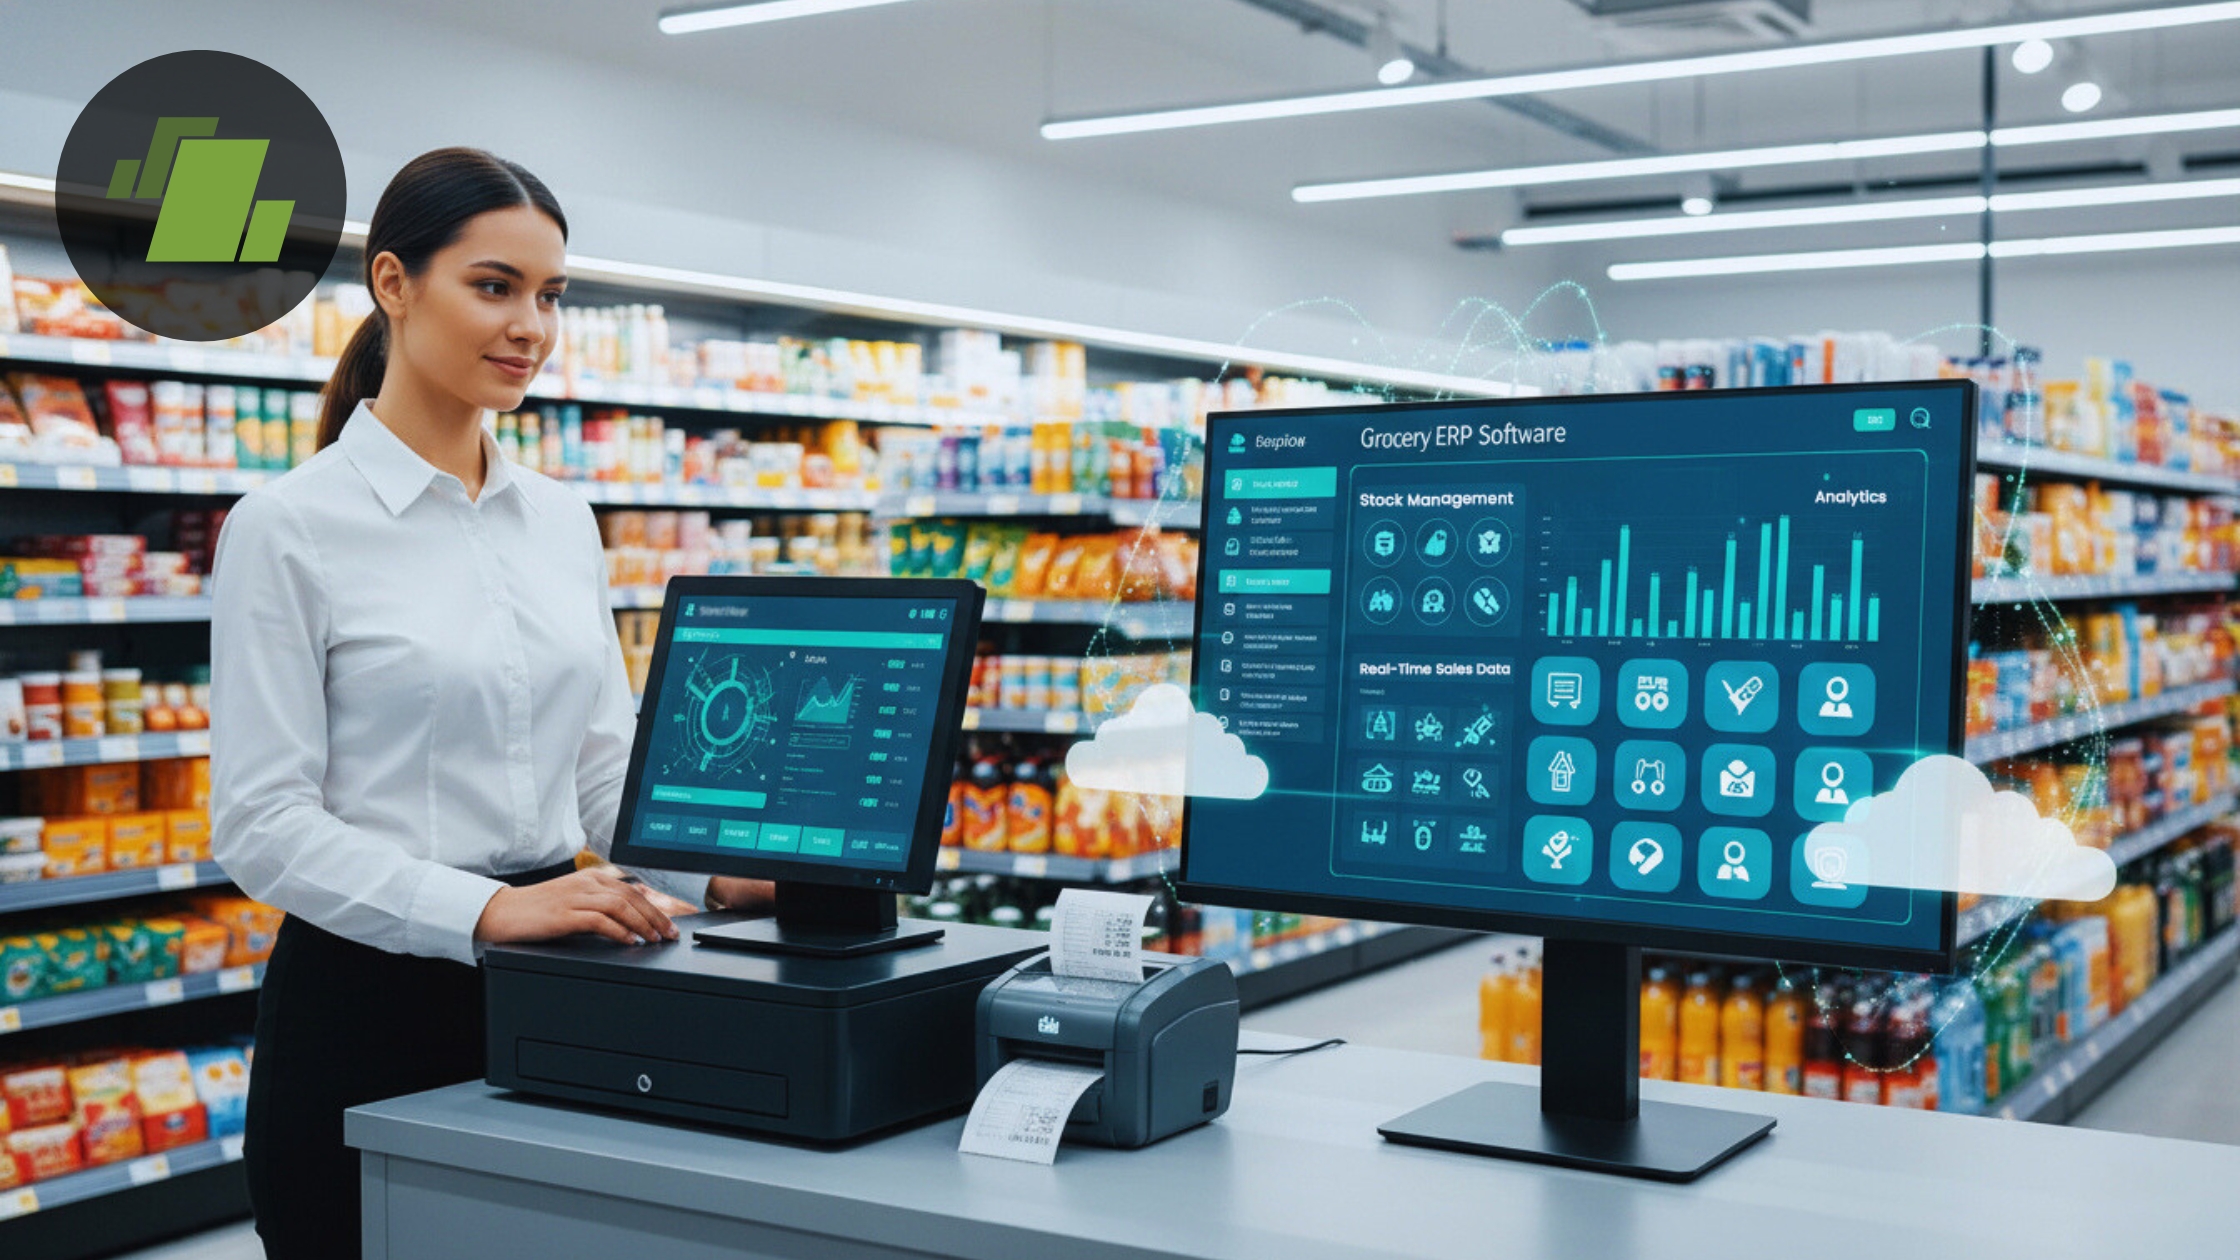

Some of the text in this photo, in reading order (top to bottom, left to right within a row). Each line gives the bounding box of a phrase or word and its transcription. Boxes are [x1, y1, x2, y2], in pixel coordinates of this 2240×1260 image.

[1361, 421, 1566, 452] Grocery ERP Software
[1360, 492, 1514, 509] Stock Management
[1814, 489, 1887, 507] Analytics
[1359, 662, 1511, 675] Real-Time Sales Data
